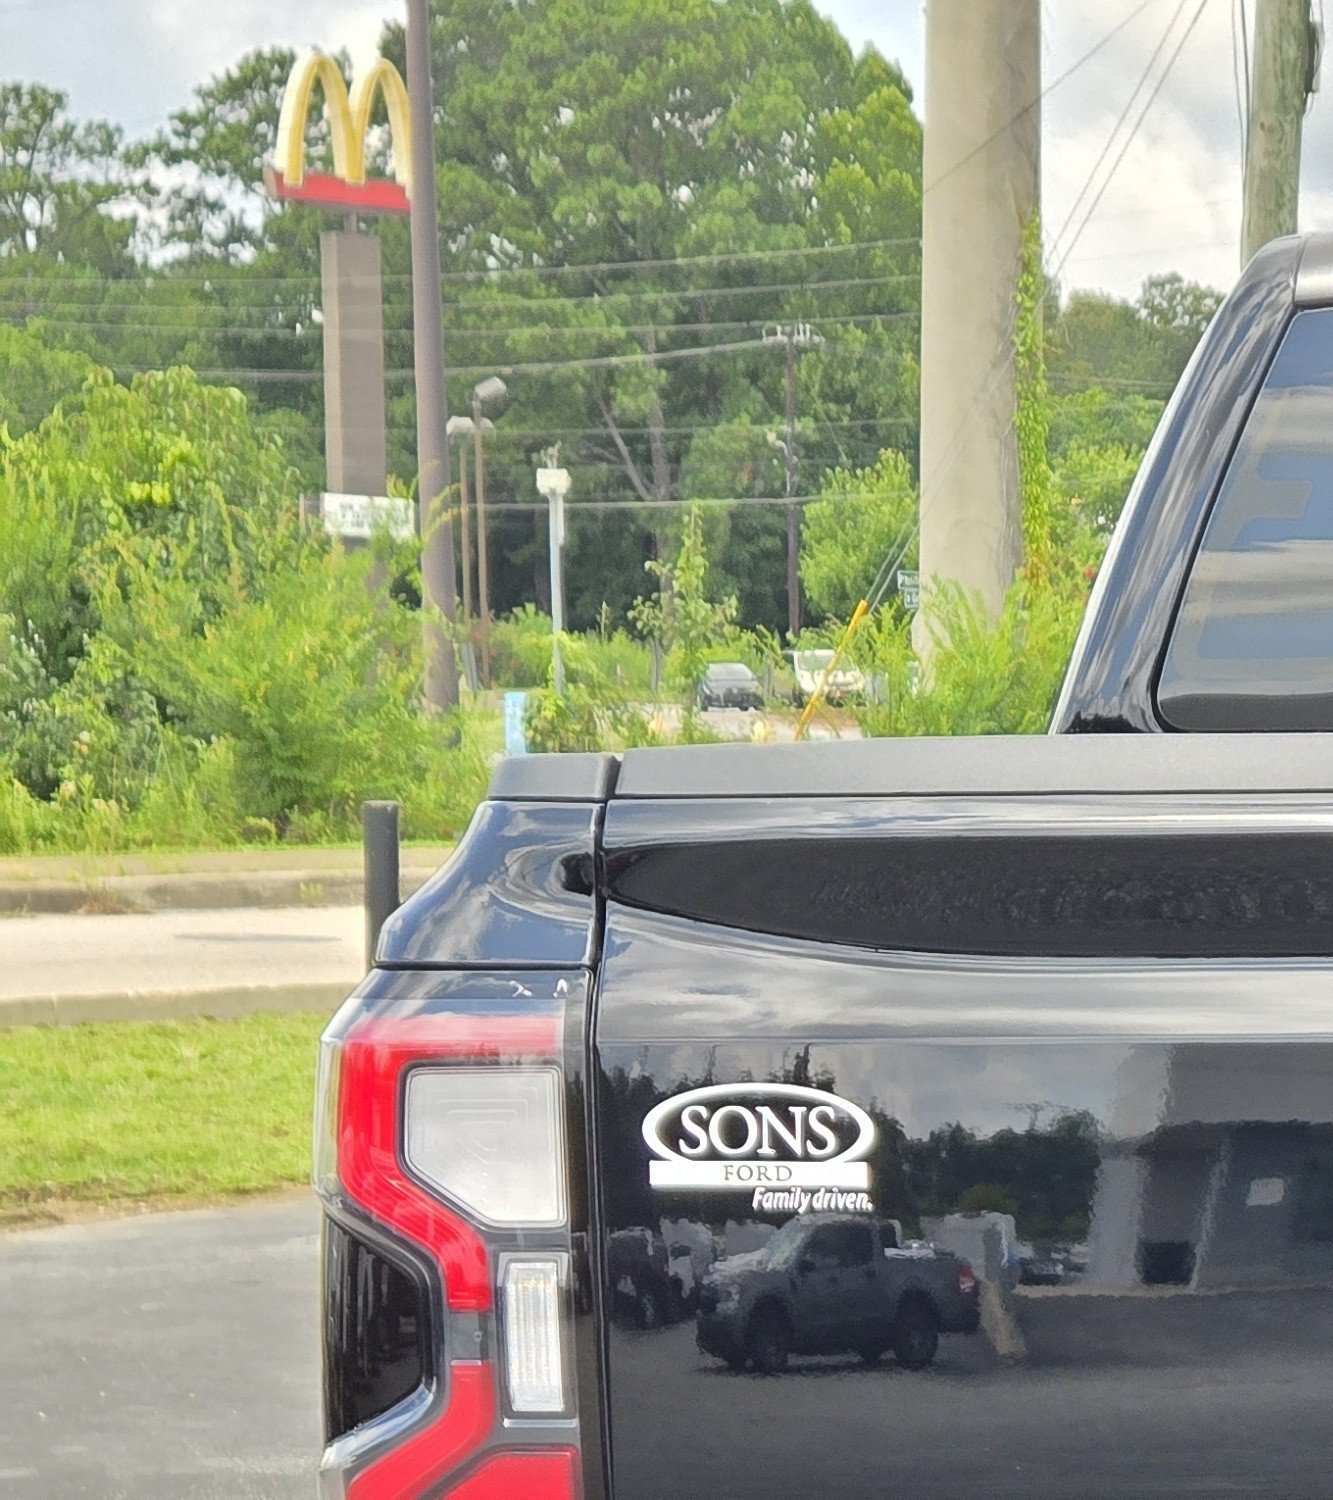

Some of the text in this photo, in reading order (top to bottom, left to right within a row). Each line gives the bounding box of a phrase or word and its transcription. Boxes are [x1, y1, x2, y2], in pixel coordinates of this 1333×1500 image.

[678, 1104, 837, 1156] SONS
[723, 1164, 793, 1182] FORD
[752, 1186, 811, 1214] Family
